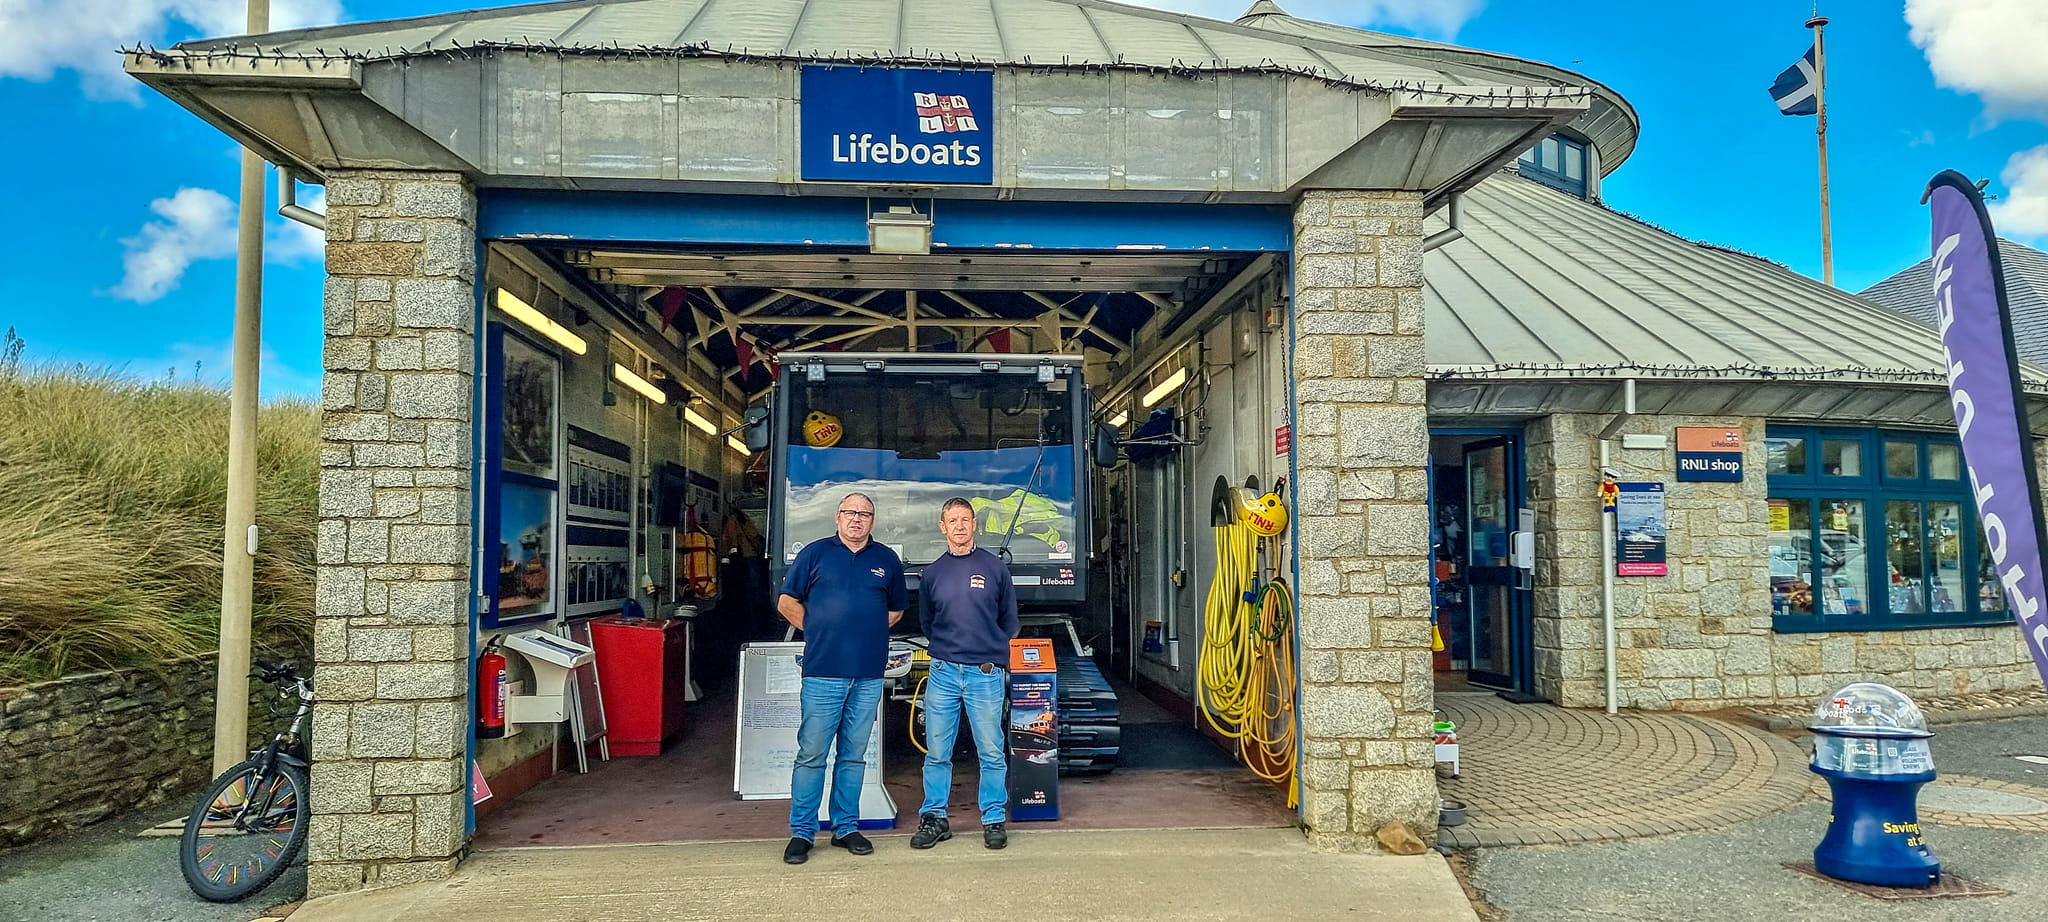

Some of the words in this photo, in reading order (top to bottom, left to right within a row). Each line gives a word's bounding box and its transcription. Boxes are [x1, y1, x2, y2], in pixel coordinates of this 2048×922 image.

[832, 133, 981, 166] Lifeboats
[1681, 458, 1709, 470] RNLI
[1711, 458, 1740, 474] shop
[1042, 577, 1075, 585] Lifeboats
[1882, 821, 1919, 835] Saving
[1907, 837, 1918, 847] at
